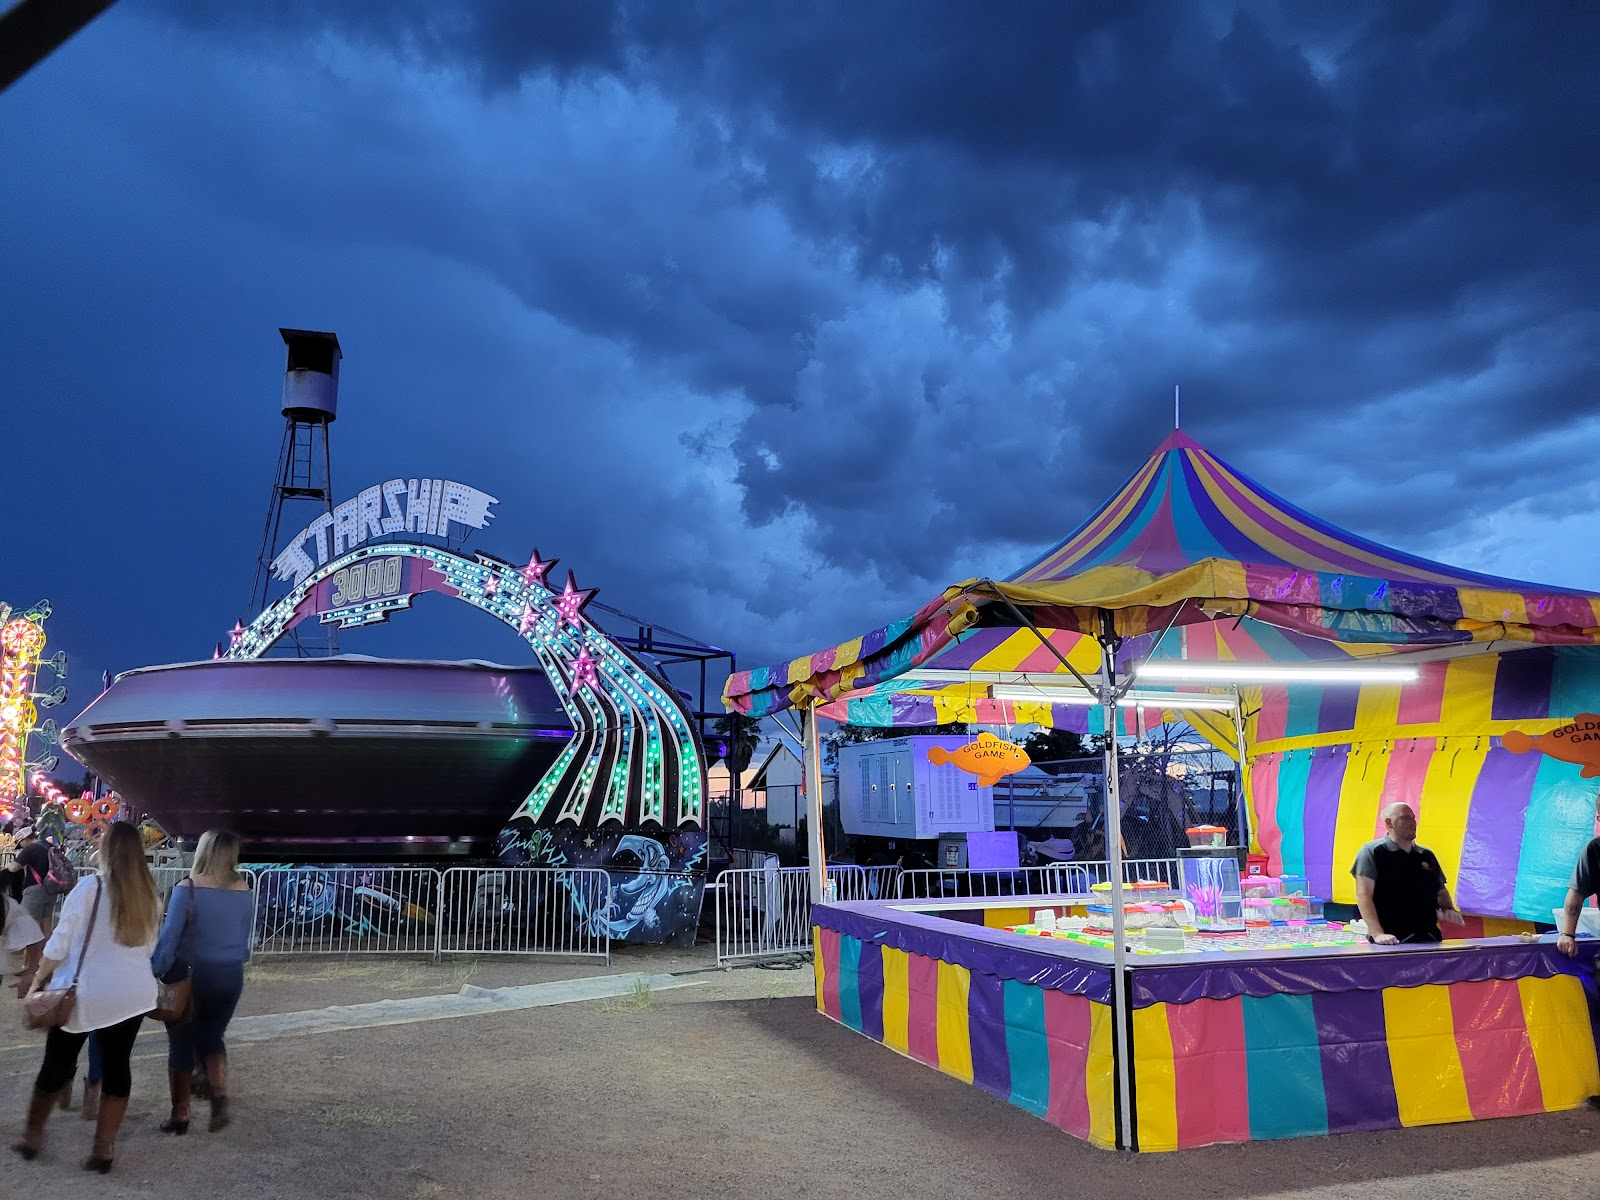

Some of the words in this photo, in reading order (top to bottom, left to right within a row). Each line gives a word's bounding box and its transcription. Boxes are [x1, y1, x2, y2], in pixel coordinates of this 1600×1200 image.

[270, 479, 500, 587] STARSHIP
[332, 556, 402, 606] 3000
[963, 741, 1017, 753] GOLDFISH
[974, 750, 1006, 759] GAME
